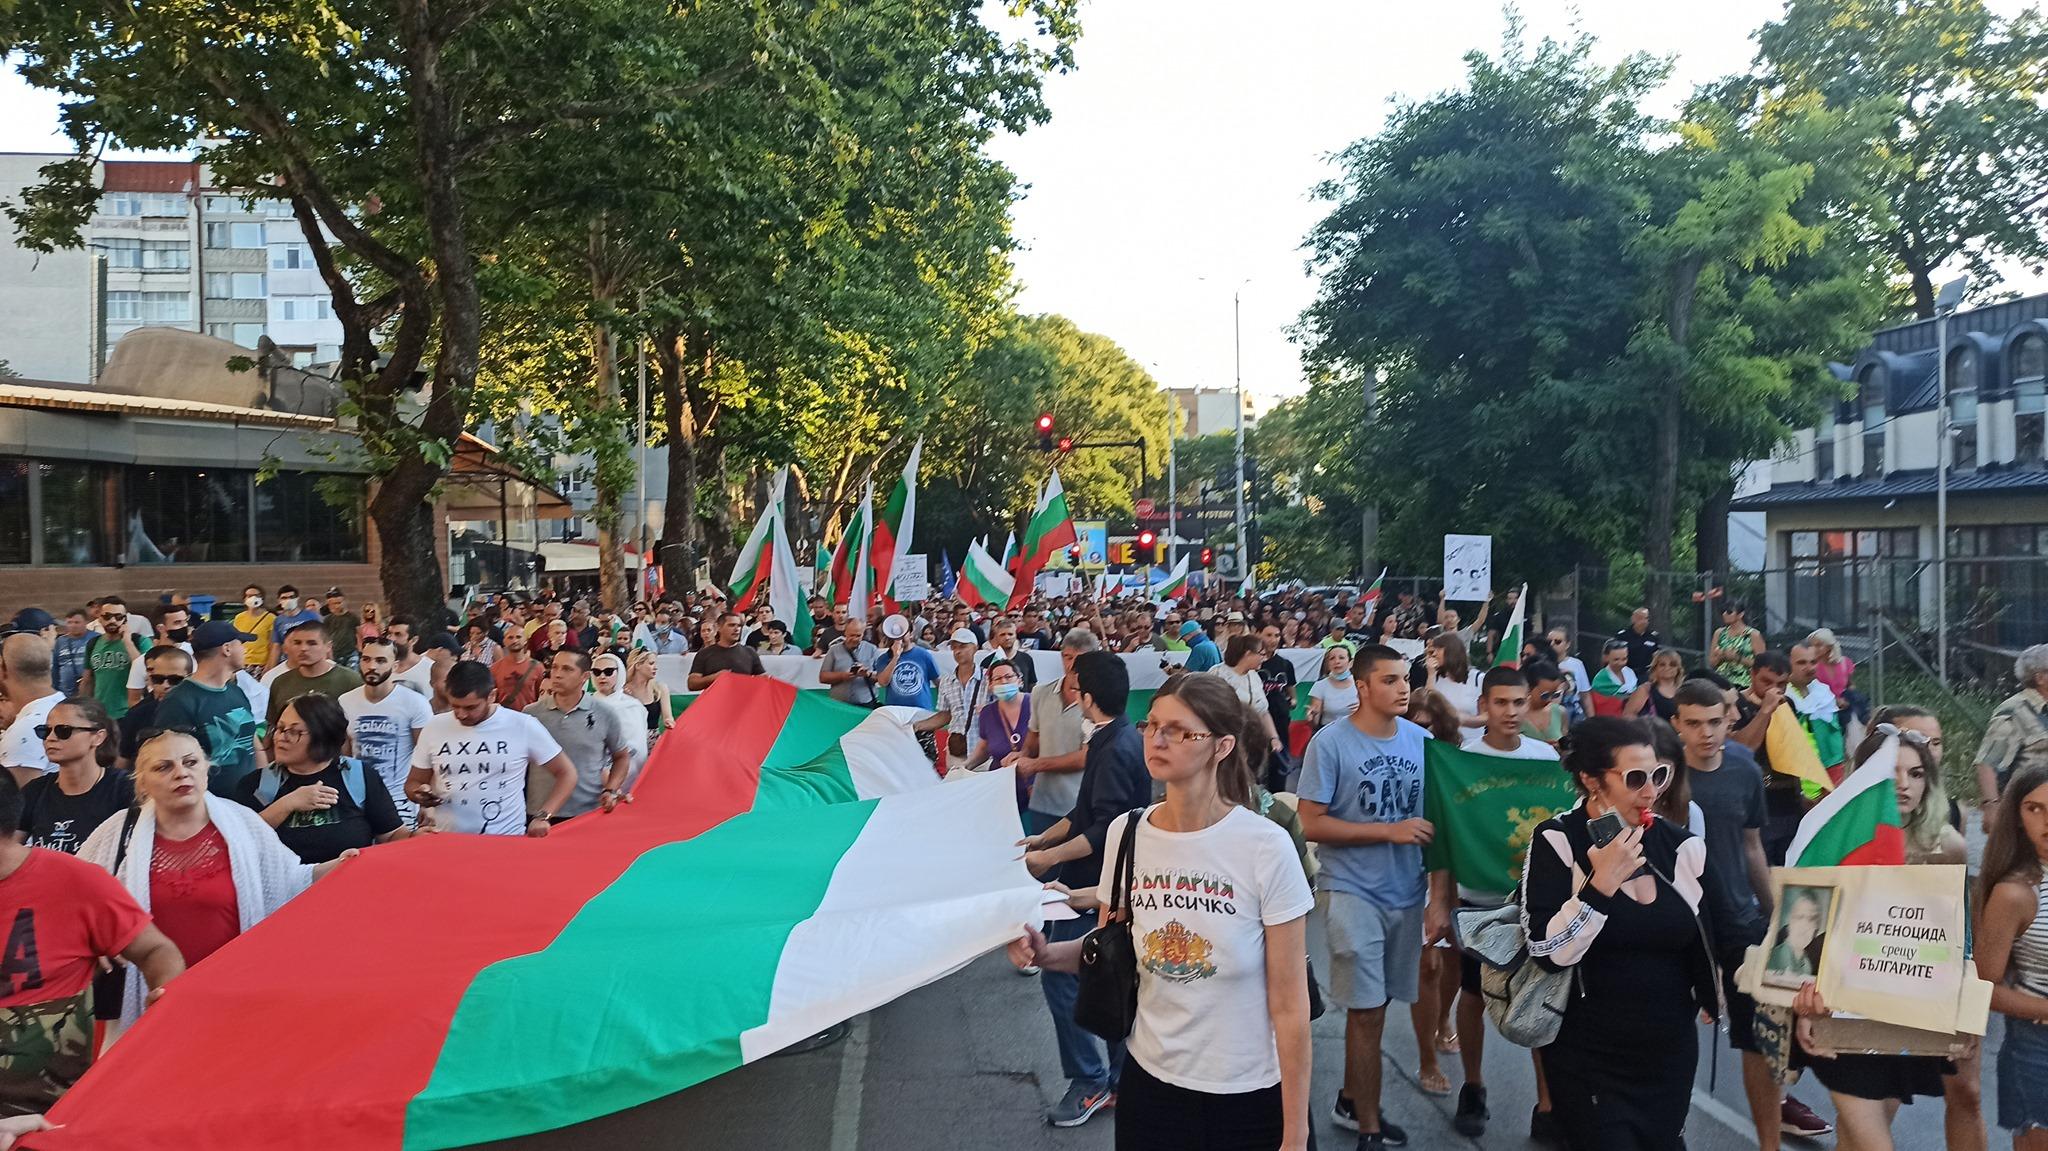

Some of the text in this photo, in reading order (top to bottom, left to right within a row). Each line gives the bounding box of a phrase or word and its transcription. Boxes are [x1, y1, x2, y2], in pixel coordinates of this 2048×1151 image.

[437, 741, 508, 756] AXAR
[1358, 755, 1384, 775] LONG
[1163, 893, 1236, 915] ВСИЧКО
[1888, 905, 1925, 920] СТОП
[1856, 921, 1947, 943] НА ГЕНОЦИДА
[1881, 945, 1917, 961] срещу
[1859, 958, 1934, 979] БЪЛГАРИТЕ
